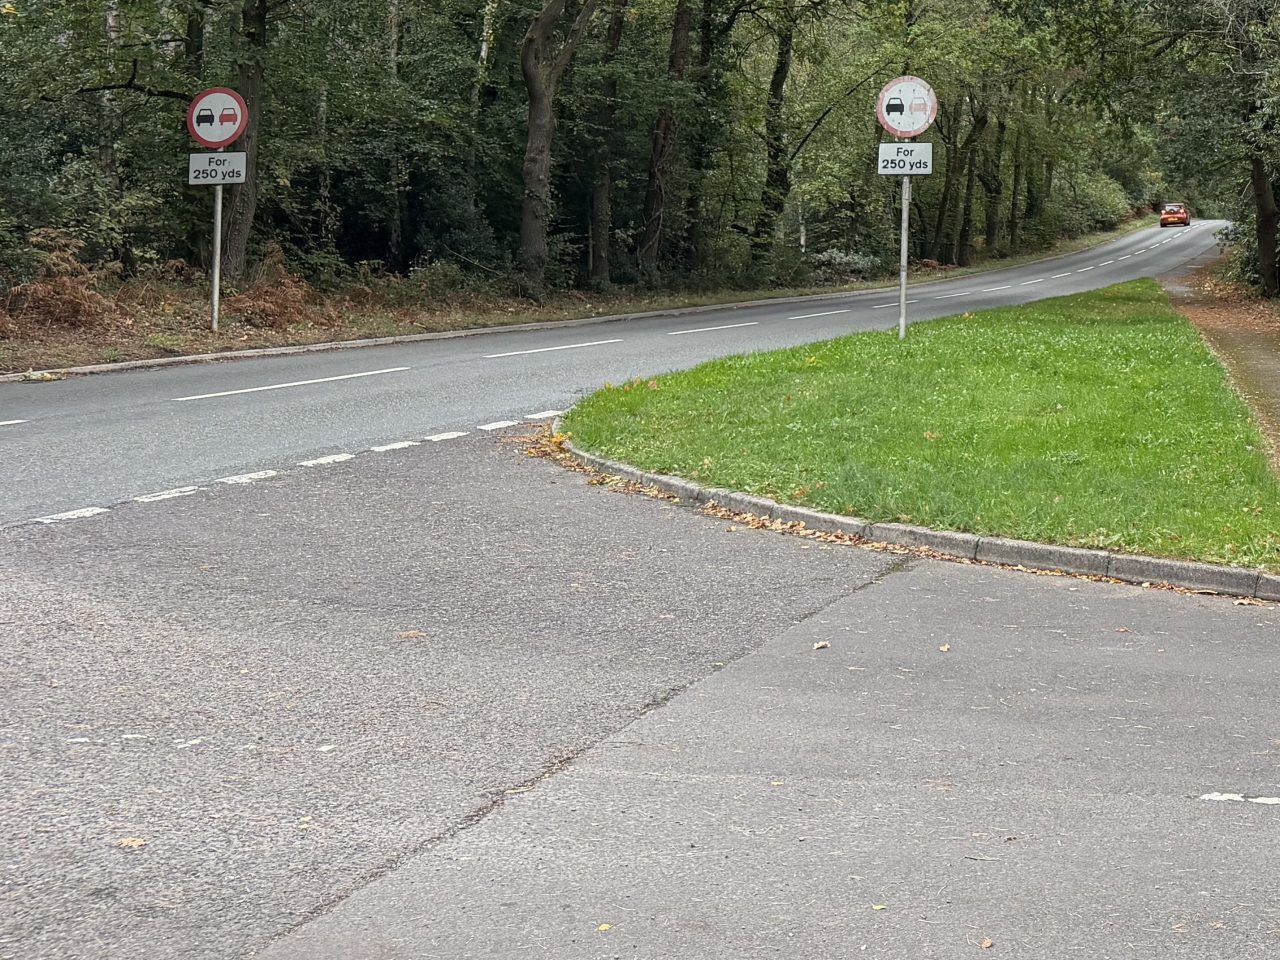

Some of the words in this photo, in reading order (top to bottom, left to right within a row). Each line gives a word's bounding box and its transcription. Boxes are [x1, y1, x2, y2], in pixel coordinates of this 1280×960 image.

[896, 147, 914, 156] For
[208, 157, 227, 167] For
[882, 159, 906, 169] 250
[909, 159, 928, 171] yds
[193, 169, 218, 179] 250
[221, 169, 242, 180] yds
